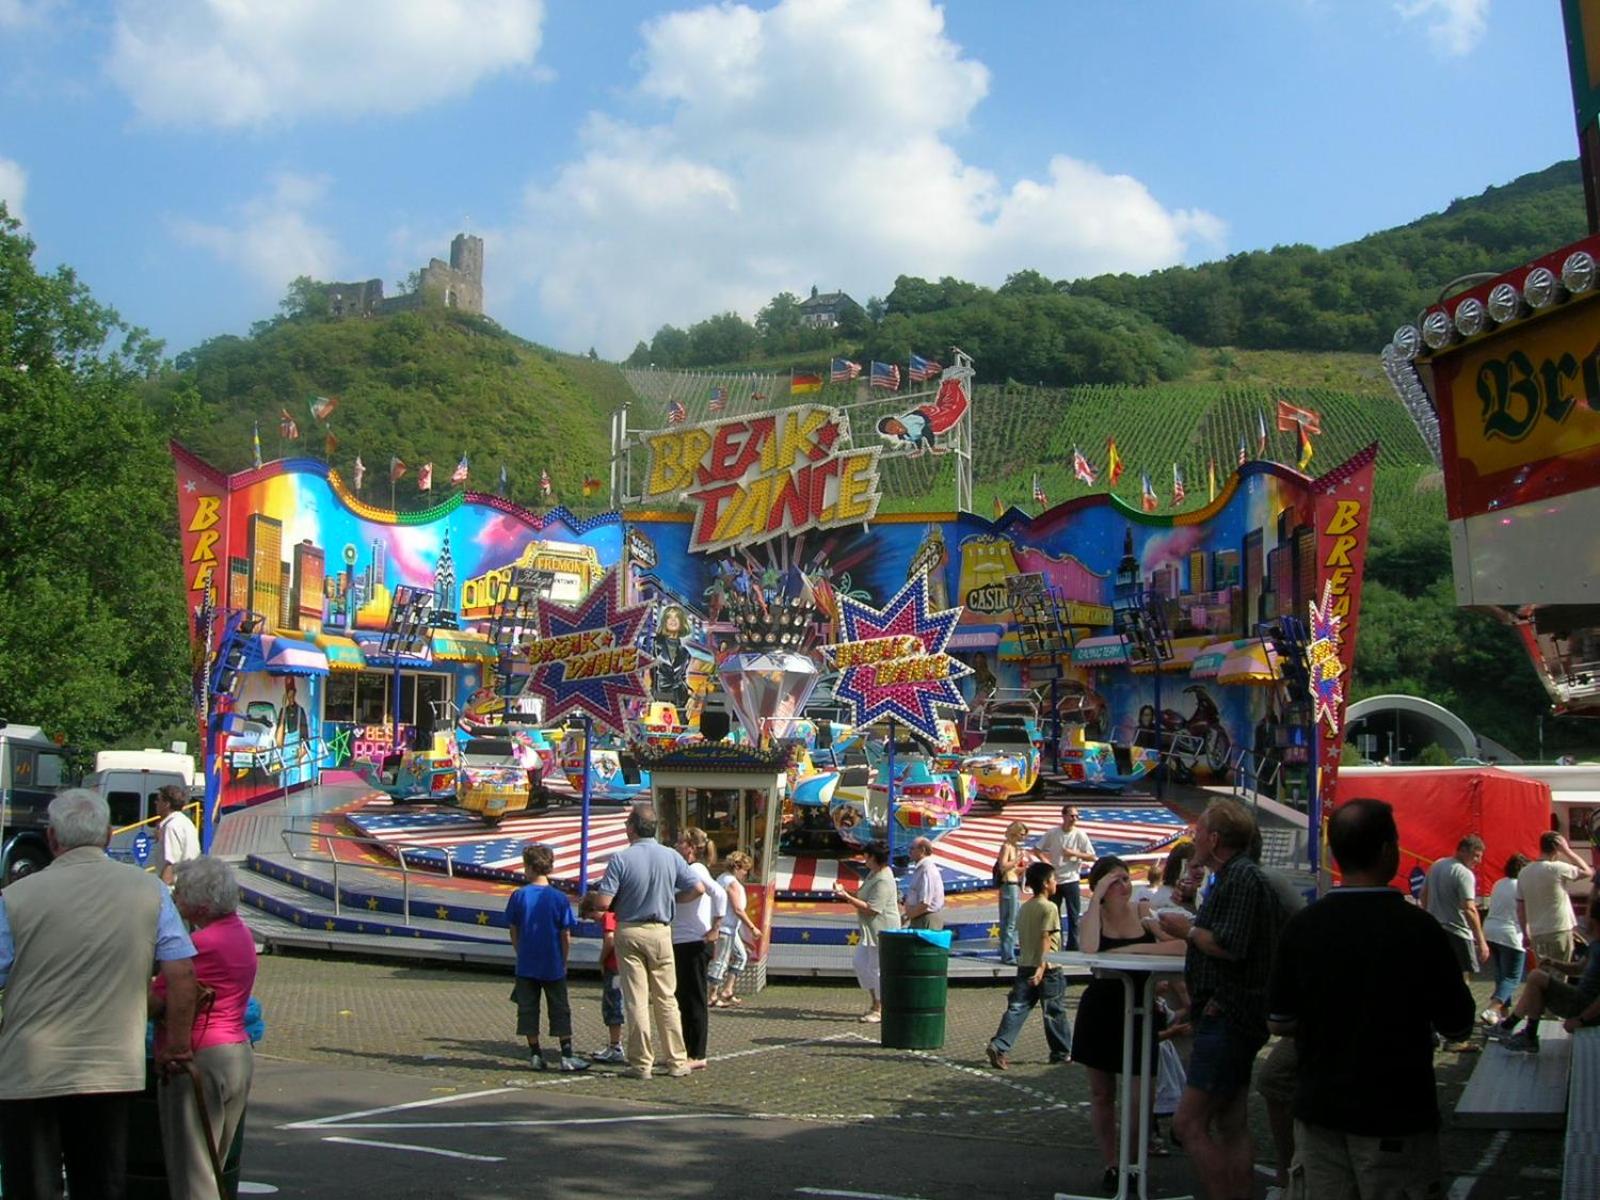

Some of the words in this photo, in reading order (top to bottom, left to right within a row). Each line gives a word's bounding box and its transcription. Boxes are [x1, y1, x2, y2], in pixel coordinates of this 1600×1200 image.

[650, 410, 830, 496] BREAK
[691, 453, 872, 545] DANCE
[529, 630, 601, 666] BREAK
[564, 648, 637, 680] DANCE
[836, 636, 911, 668] BREAK
[876, 655, 949, 686] DANCE
